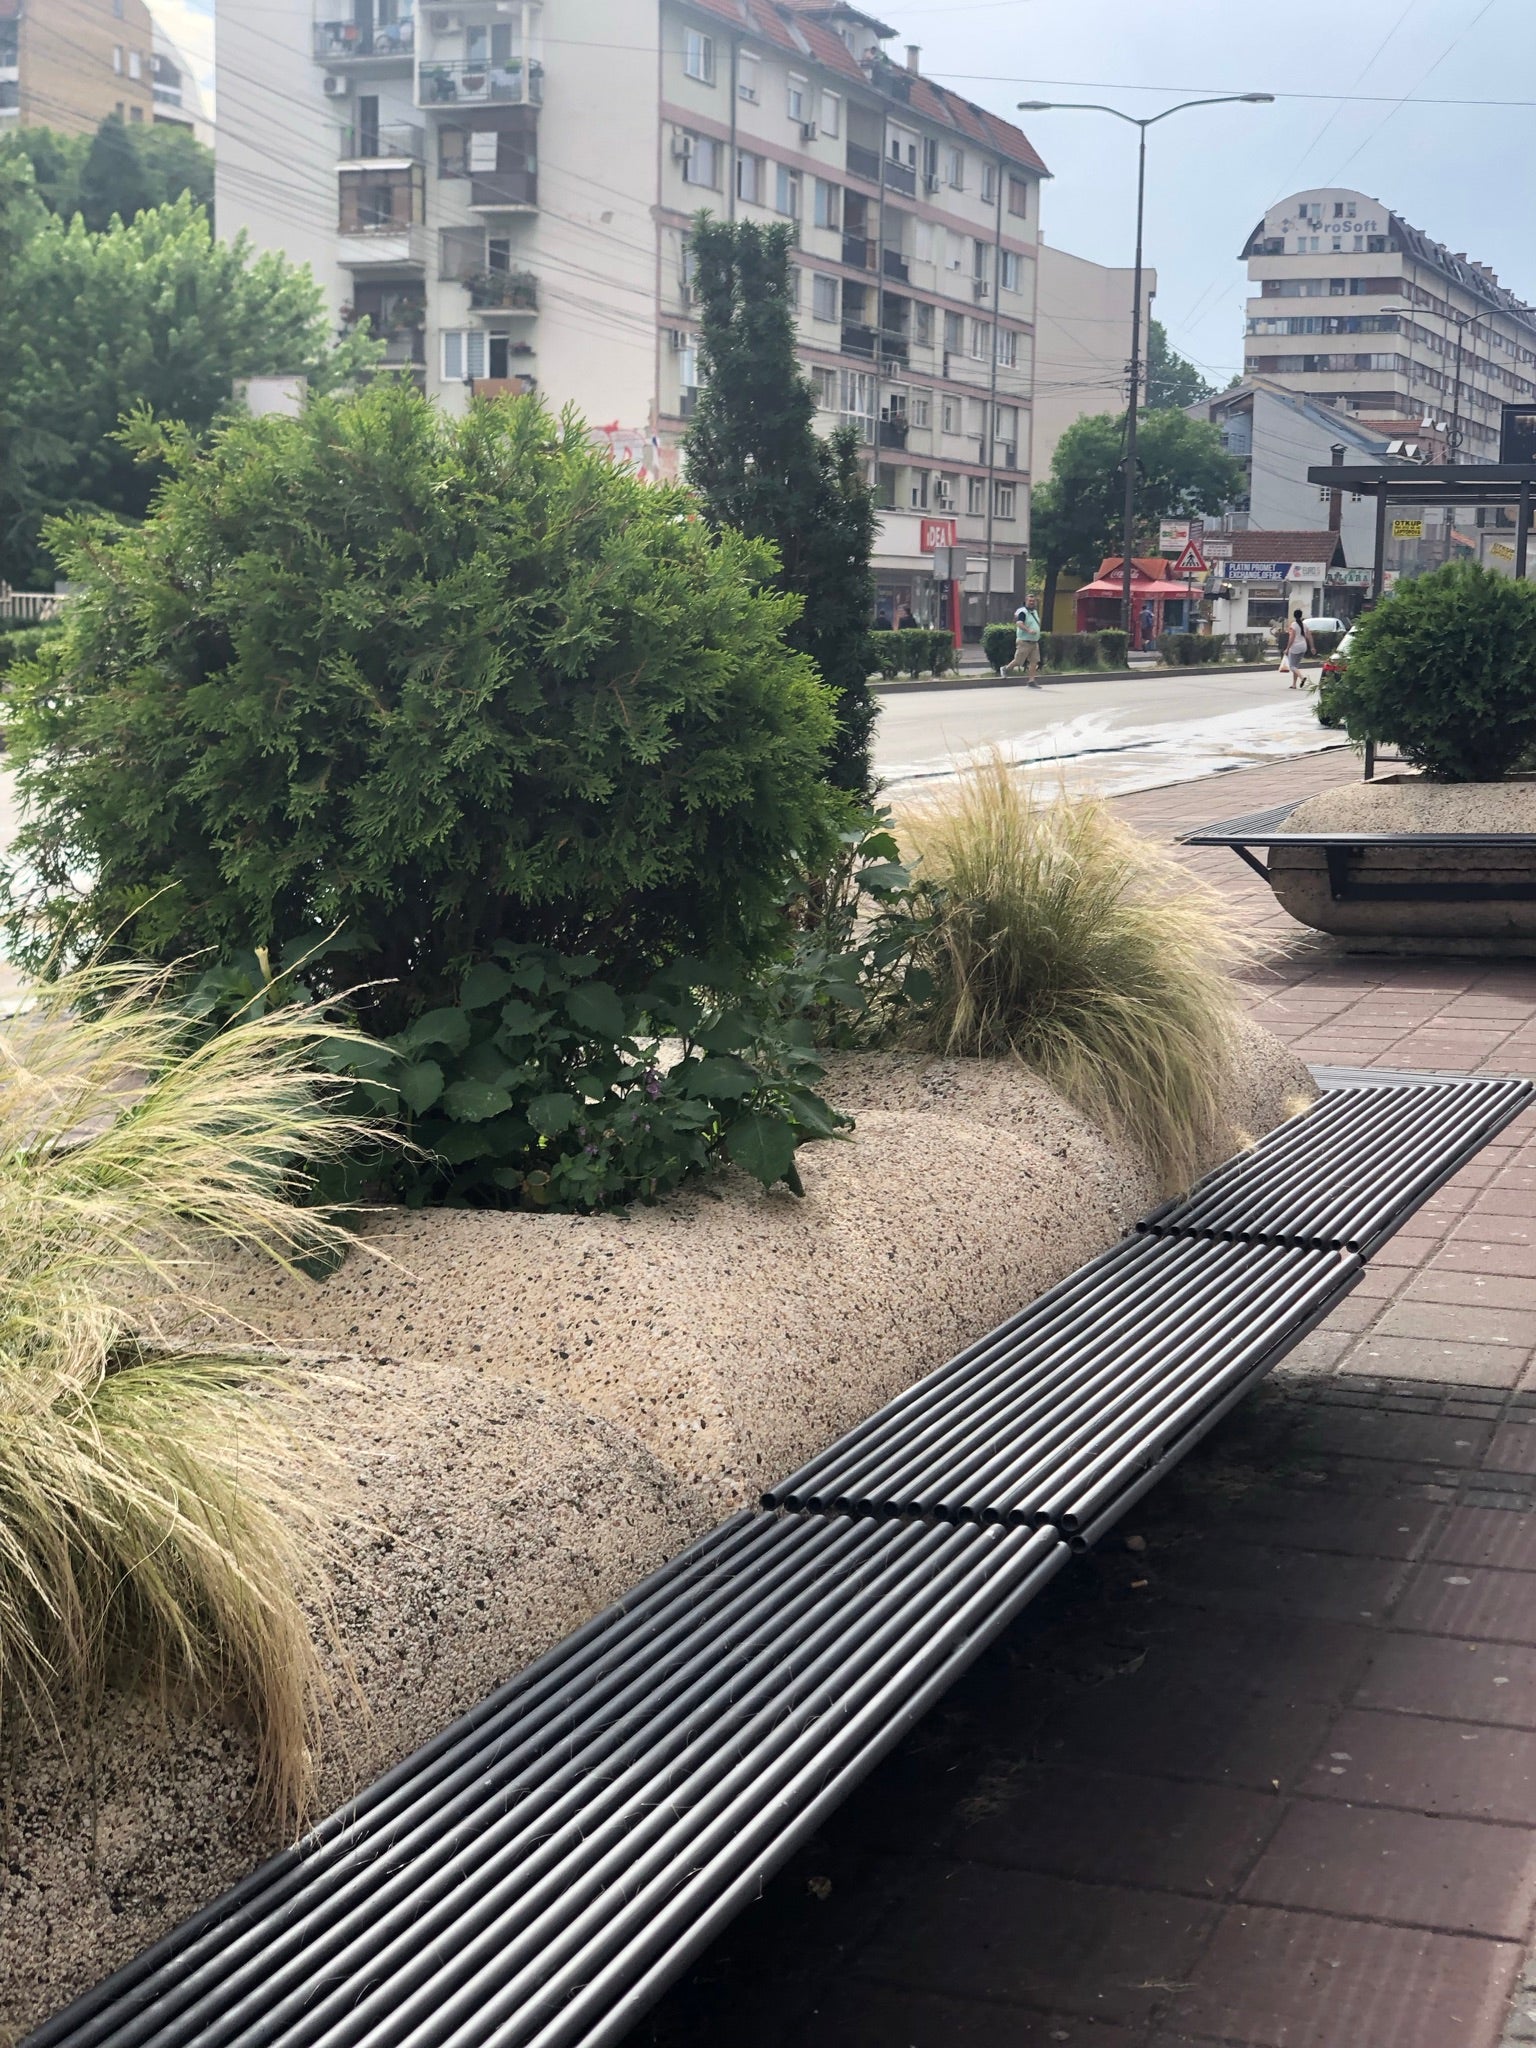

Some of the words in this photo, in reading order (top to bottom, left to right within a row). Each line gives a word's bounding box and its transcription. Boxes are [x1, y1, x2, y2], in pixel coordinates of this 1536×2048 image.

[1312, 220, 1377, 233] ProSoft
[1229, 563, 1250, 571] PLATNI
[1251, 563, 1276, 571] PROMET
[1229, 571, 1261, 579] EXCHANGE
[1262, 571, 1283, 579] OFFICE
